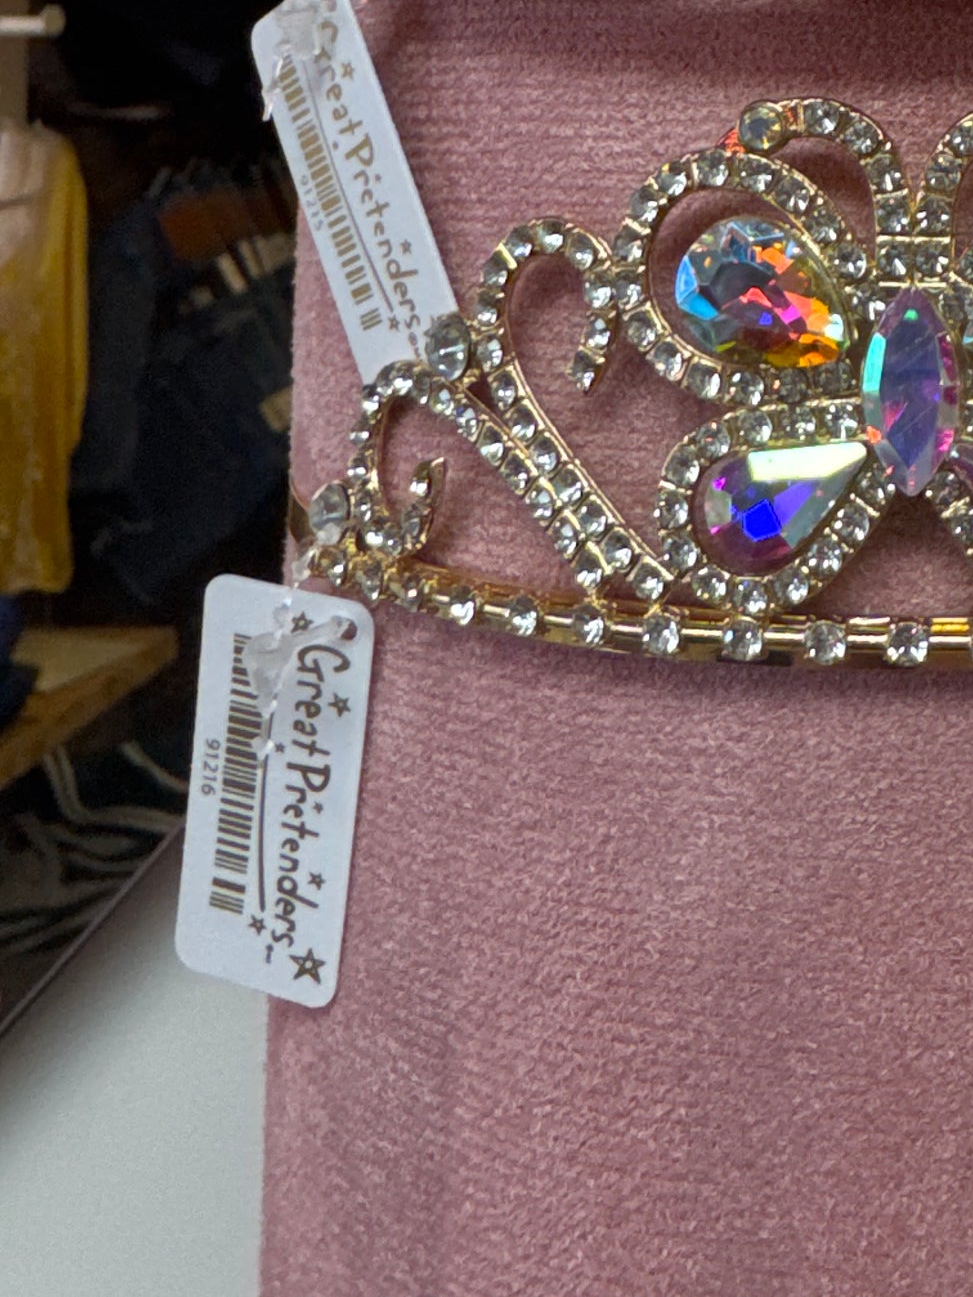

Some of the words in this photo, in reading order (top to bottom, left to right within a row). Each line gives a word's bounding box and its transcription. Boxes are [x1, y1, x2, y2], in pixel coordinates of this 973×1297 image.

[299, 174, 324, 232] 91215
[314, 21, 363, 136] Great
[345, 134, 420, 330] Pretenders
[290, 644, 351, 757] Great
[201, 738, 222, 797] 91216
[270, 762, 332, 946] Pretenders
